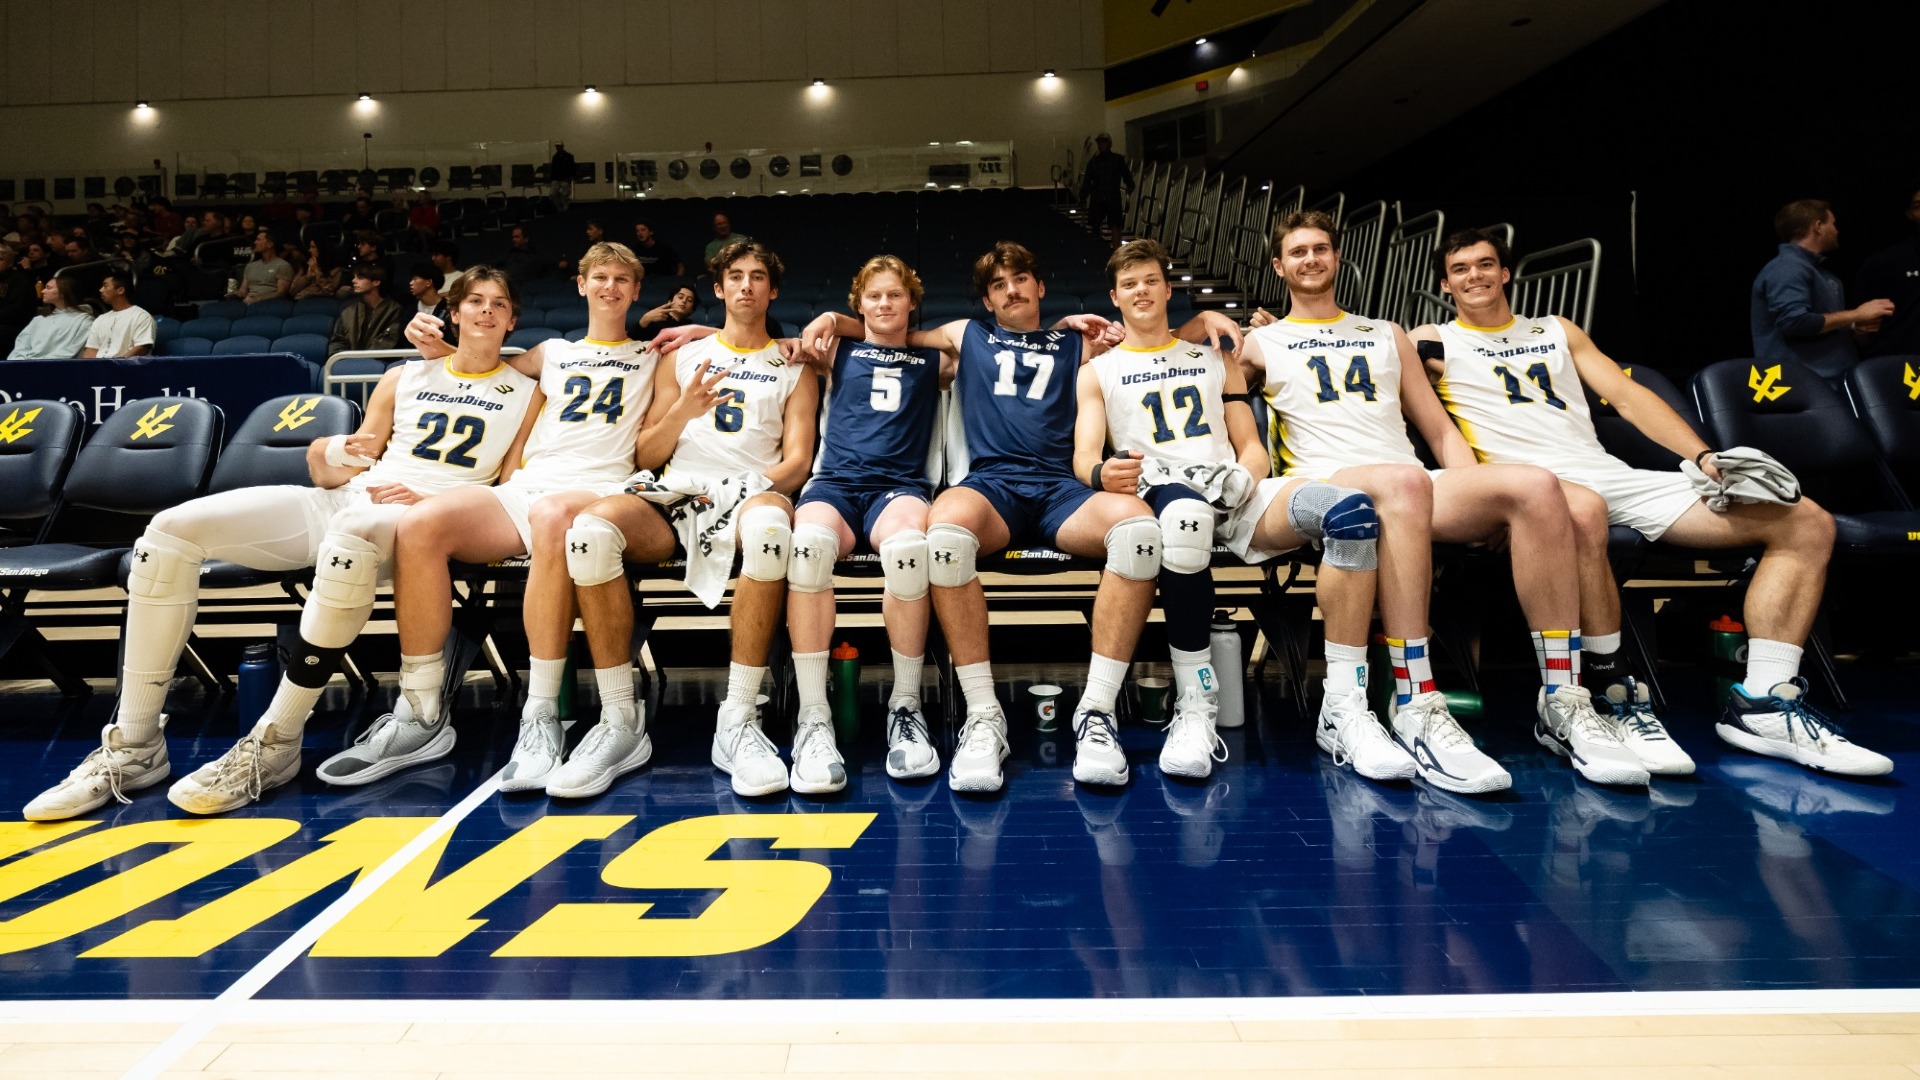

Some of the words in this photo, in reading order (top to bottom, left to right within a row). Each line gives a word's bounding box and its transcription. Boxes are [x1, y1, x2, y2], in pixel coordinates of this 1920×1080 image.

[851, 348, 926, 365] UCSanDiego
[993, 349, 1055, 401] 17
[1121, 366, 1206, 386] UCSanDiego
[1305, 355, 1378, 404] 14
[416, 391, 504, 411] UCSanDiego
[559, 374, 625, 425] 24
[714, 386, 746, 433] 6
[869, 366, 903, 412] 5
[1492, 361, 1568, 411] 11
[1140, 384, 1213, 445] 12
[410, 410, 487, 470] 22
[1005, 549, 1072, 561] UCSanDiego
